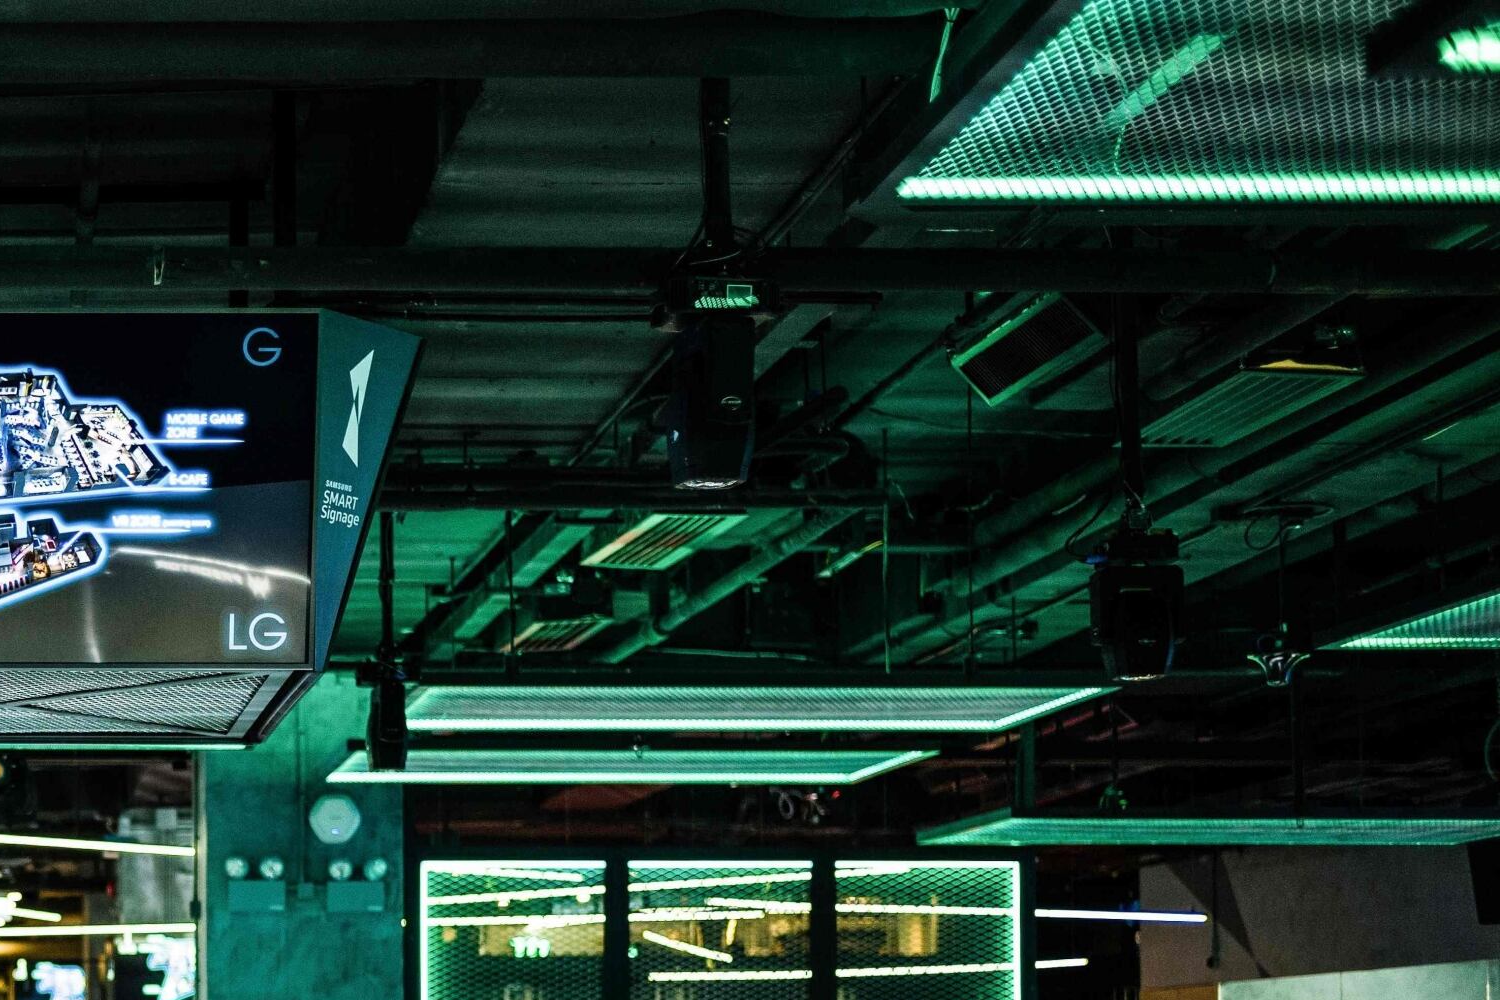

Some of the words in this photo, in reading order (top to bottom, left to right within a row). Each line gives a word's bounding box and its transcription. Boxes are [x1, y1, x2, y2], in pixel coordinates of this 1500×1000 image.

[166, 413, 207, 425] MOBILE
[209, 413, 244, 425] GAME
[166, 427, 197, 439] ZONE
[325, 480, 352, 492] SAMSUNG
[323, 490, 359, 510] SMART
[321, 505, 360, 528] Signage
[229, 613, 287, 650] LG
